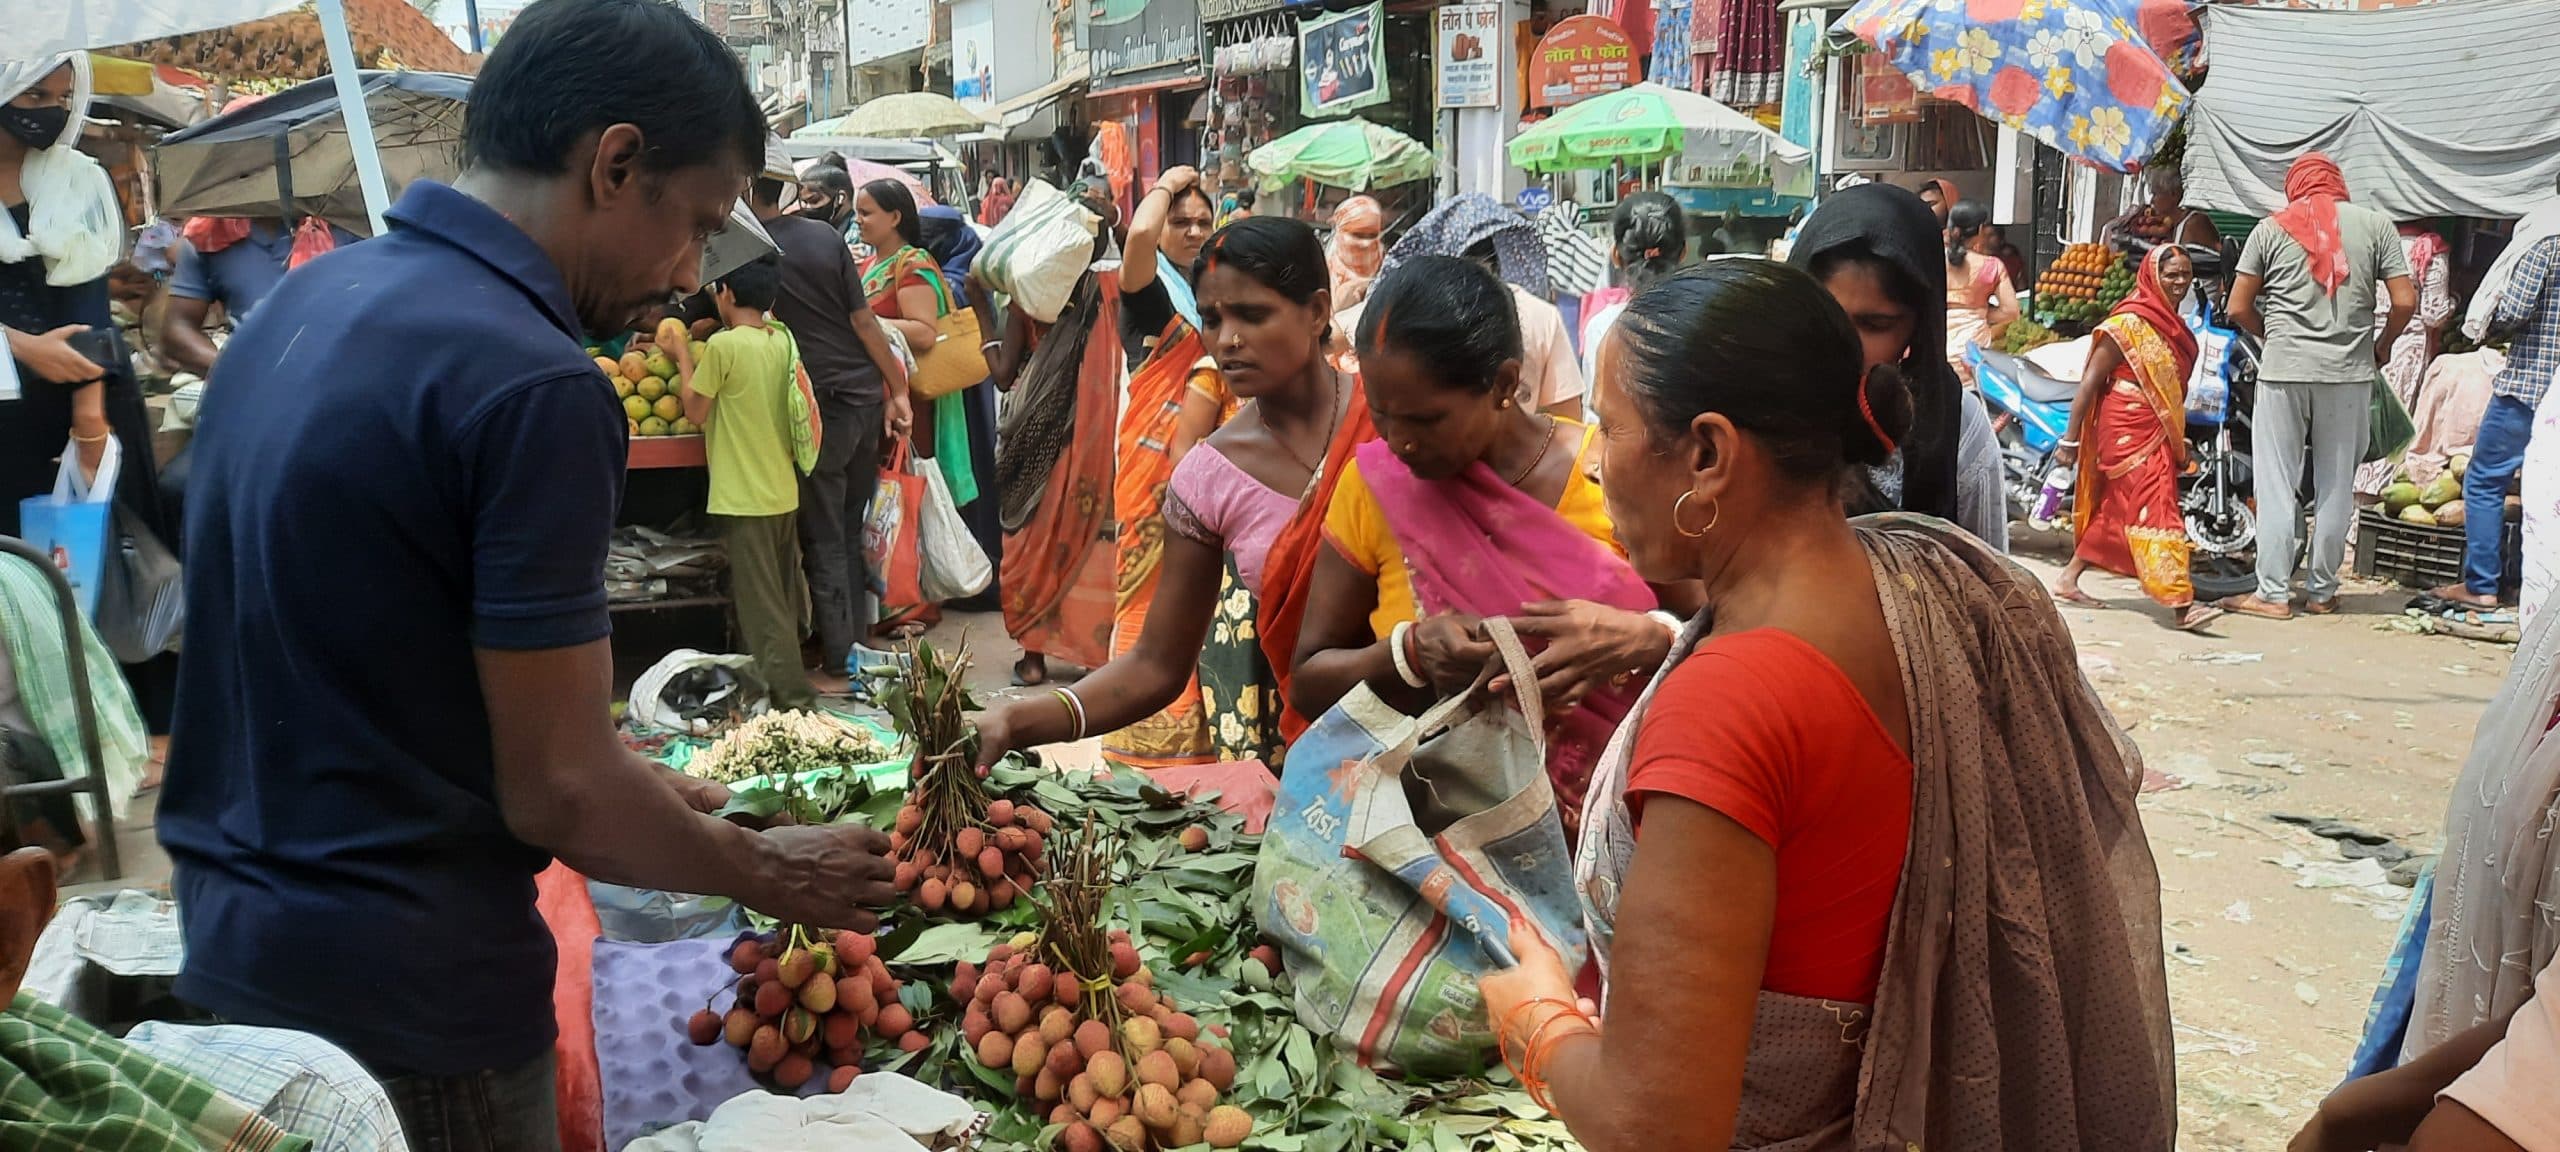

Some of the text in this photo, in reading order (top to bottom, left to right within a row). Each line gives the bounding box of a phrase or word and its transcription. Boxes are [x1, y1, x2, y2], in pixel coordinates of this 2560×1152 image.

[1441, 8, 1462, 31] लोन
[1544, 42, 1629, 63] लोन पे फोन
